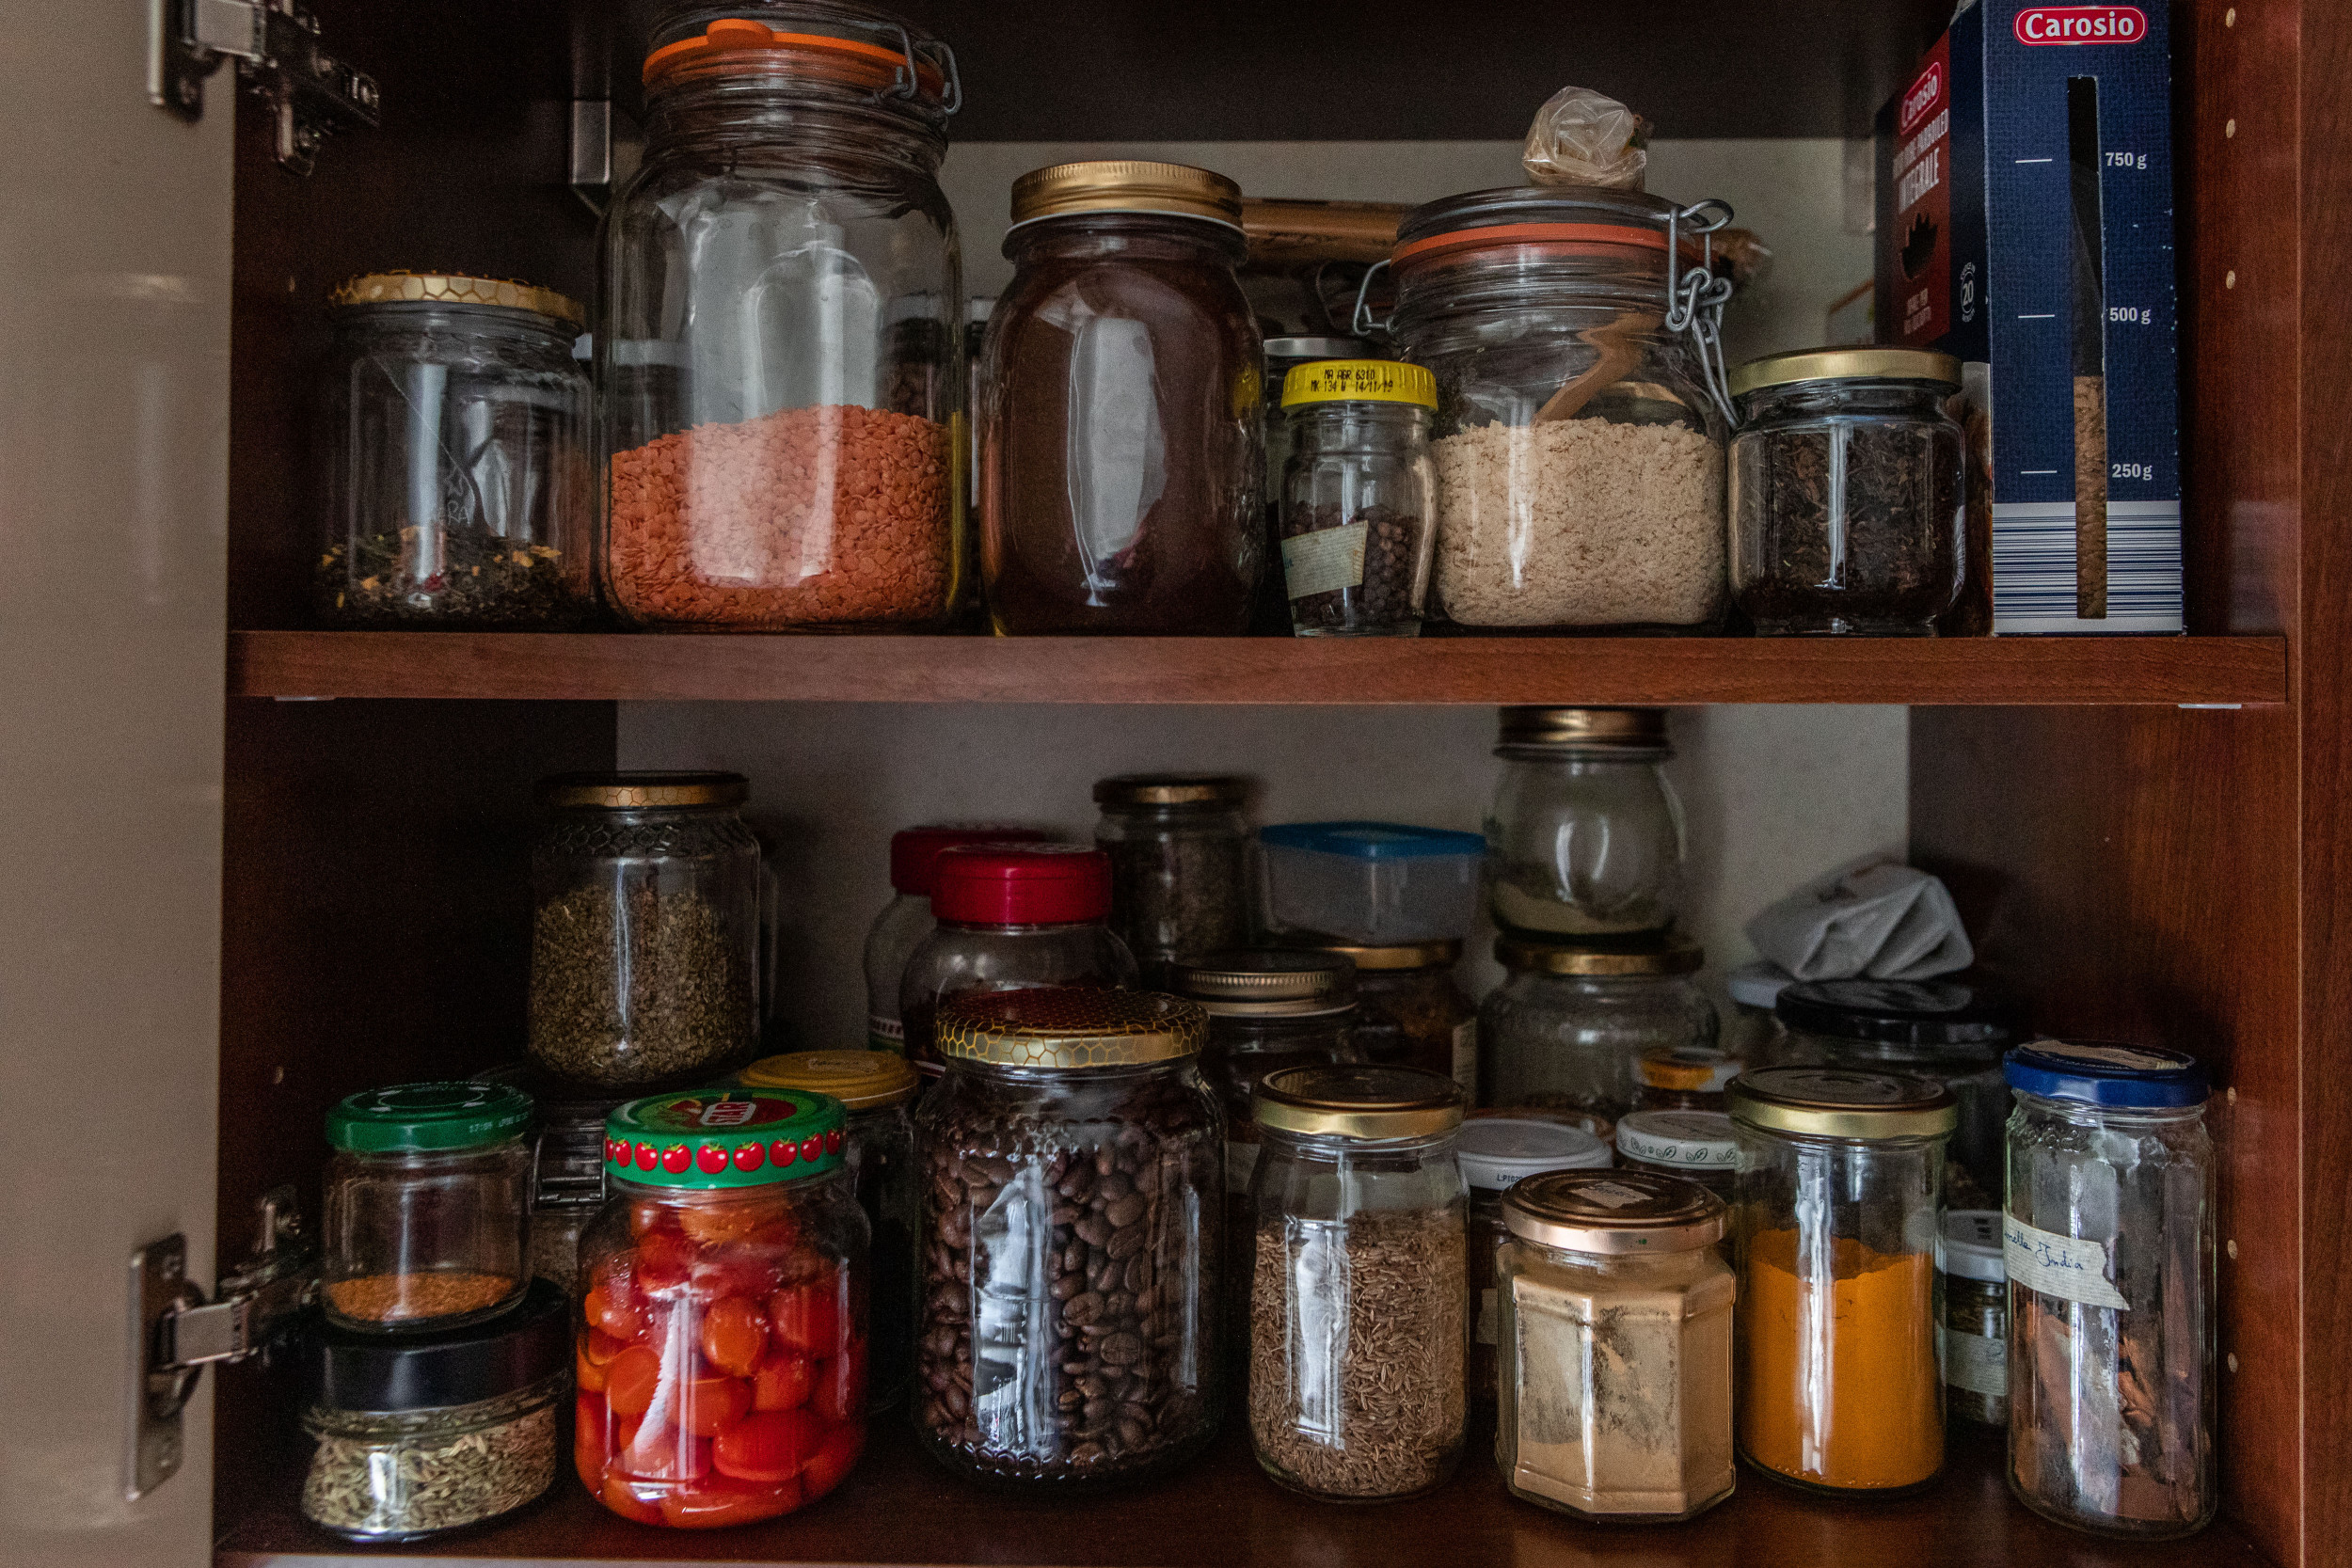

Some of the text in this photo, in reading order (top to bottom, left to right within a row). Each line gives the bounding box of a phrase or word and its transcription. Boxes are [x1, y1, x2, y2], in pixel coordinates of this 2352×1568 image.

[2025, 11, 2135, 40] Carosio
[1901, 72, 1938, 129] Carosio
[2105, 151, 2148, 170] 750 g
[1962, 279, 1975, 307] 20
[2109, 307, 2152, 325] 500 g
[2111, 464, 2153, 481] 250 g
